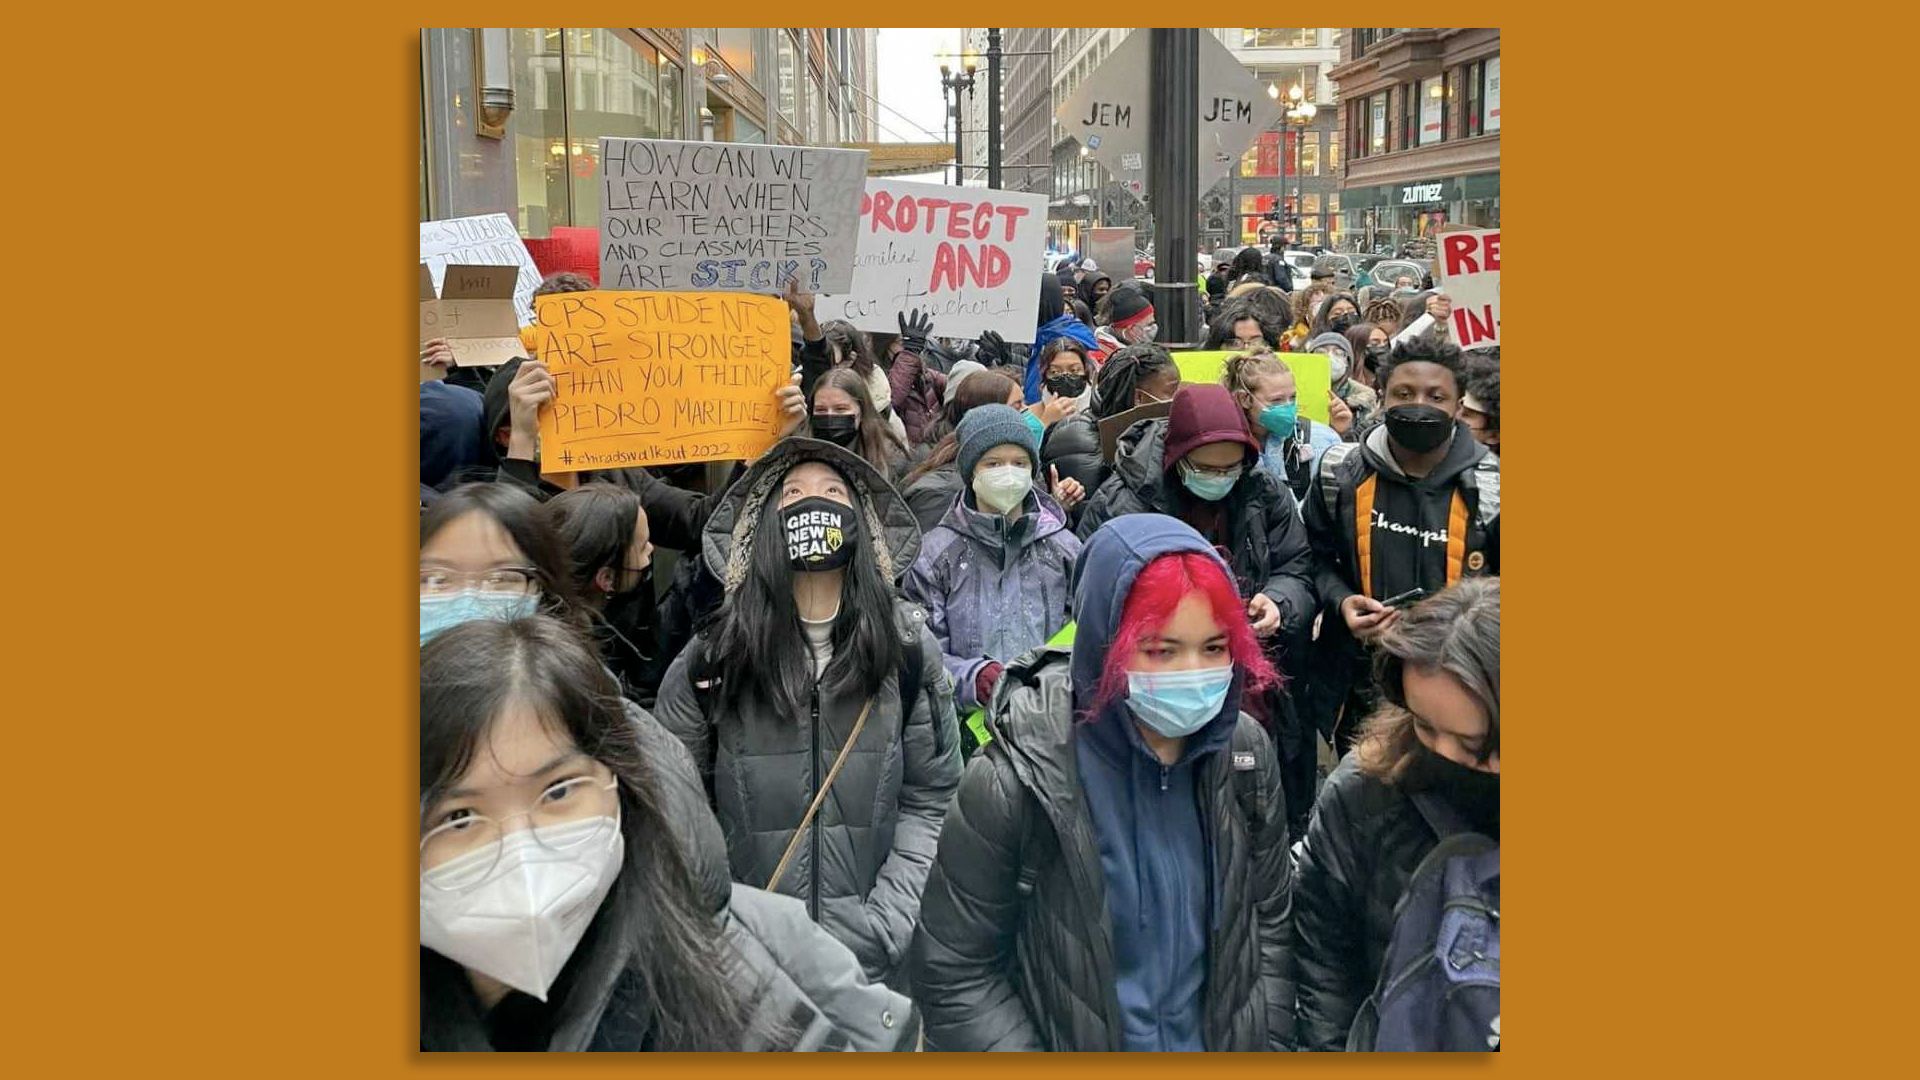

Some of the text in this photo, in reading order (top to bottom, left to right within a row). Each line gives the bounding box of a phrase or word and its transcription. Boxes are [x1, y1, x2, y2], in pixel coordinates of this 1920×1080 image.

[1082, 101, 1131, 129] JEM
[1204, 98, 1252, 124] JEM
[604, 140, 815, 180] HOW CAN WE
[607, 181, 811, 212] LEARN WHEN
[607, 214, 828, 239] OUR TEACHERS
[605, 239, 822, 261] AND CLASSMATES
[853, 242, 919, 267] amilies
[617, 265, 679, 288] ARE
[929, 241, 1011, 293] AND
[538, 297, 606, 329] CPS
[614, 295, 776, 335] STUDENTS
[544, 331, 617, 366] ARE
[628, 330, 779, 365] STRONGER
[550, 367, 624, 398] THAN
[641, 363, 682, 392] YOU
[553, 397, 660, 434] PEDRO
[787, 511, 842, 529] GREEN
[1371, 509, 1449, 547] hampi
[788, 526, 825, 544] NEW
[788, 540, 832, 560] DEAL
